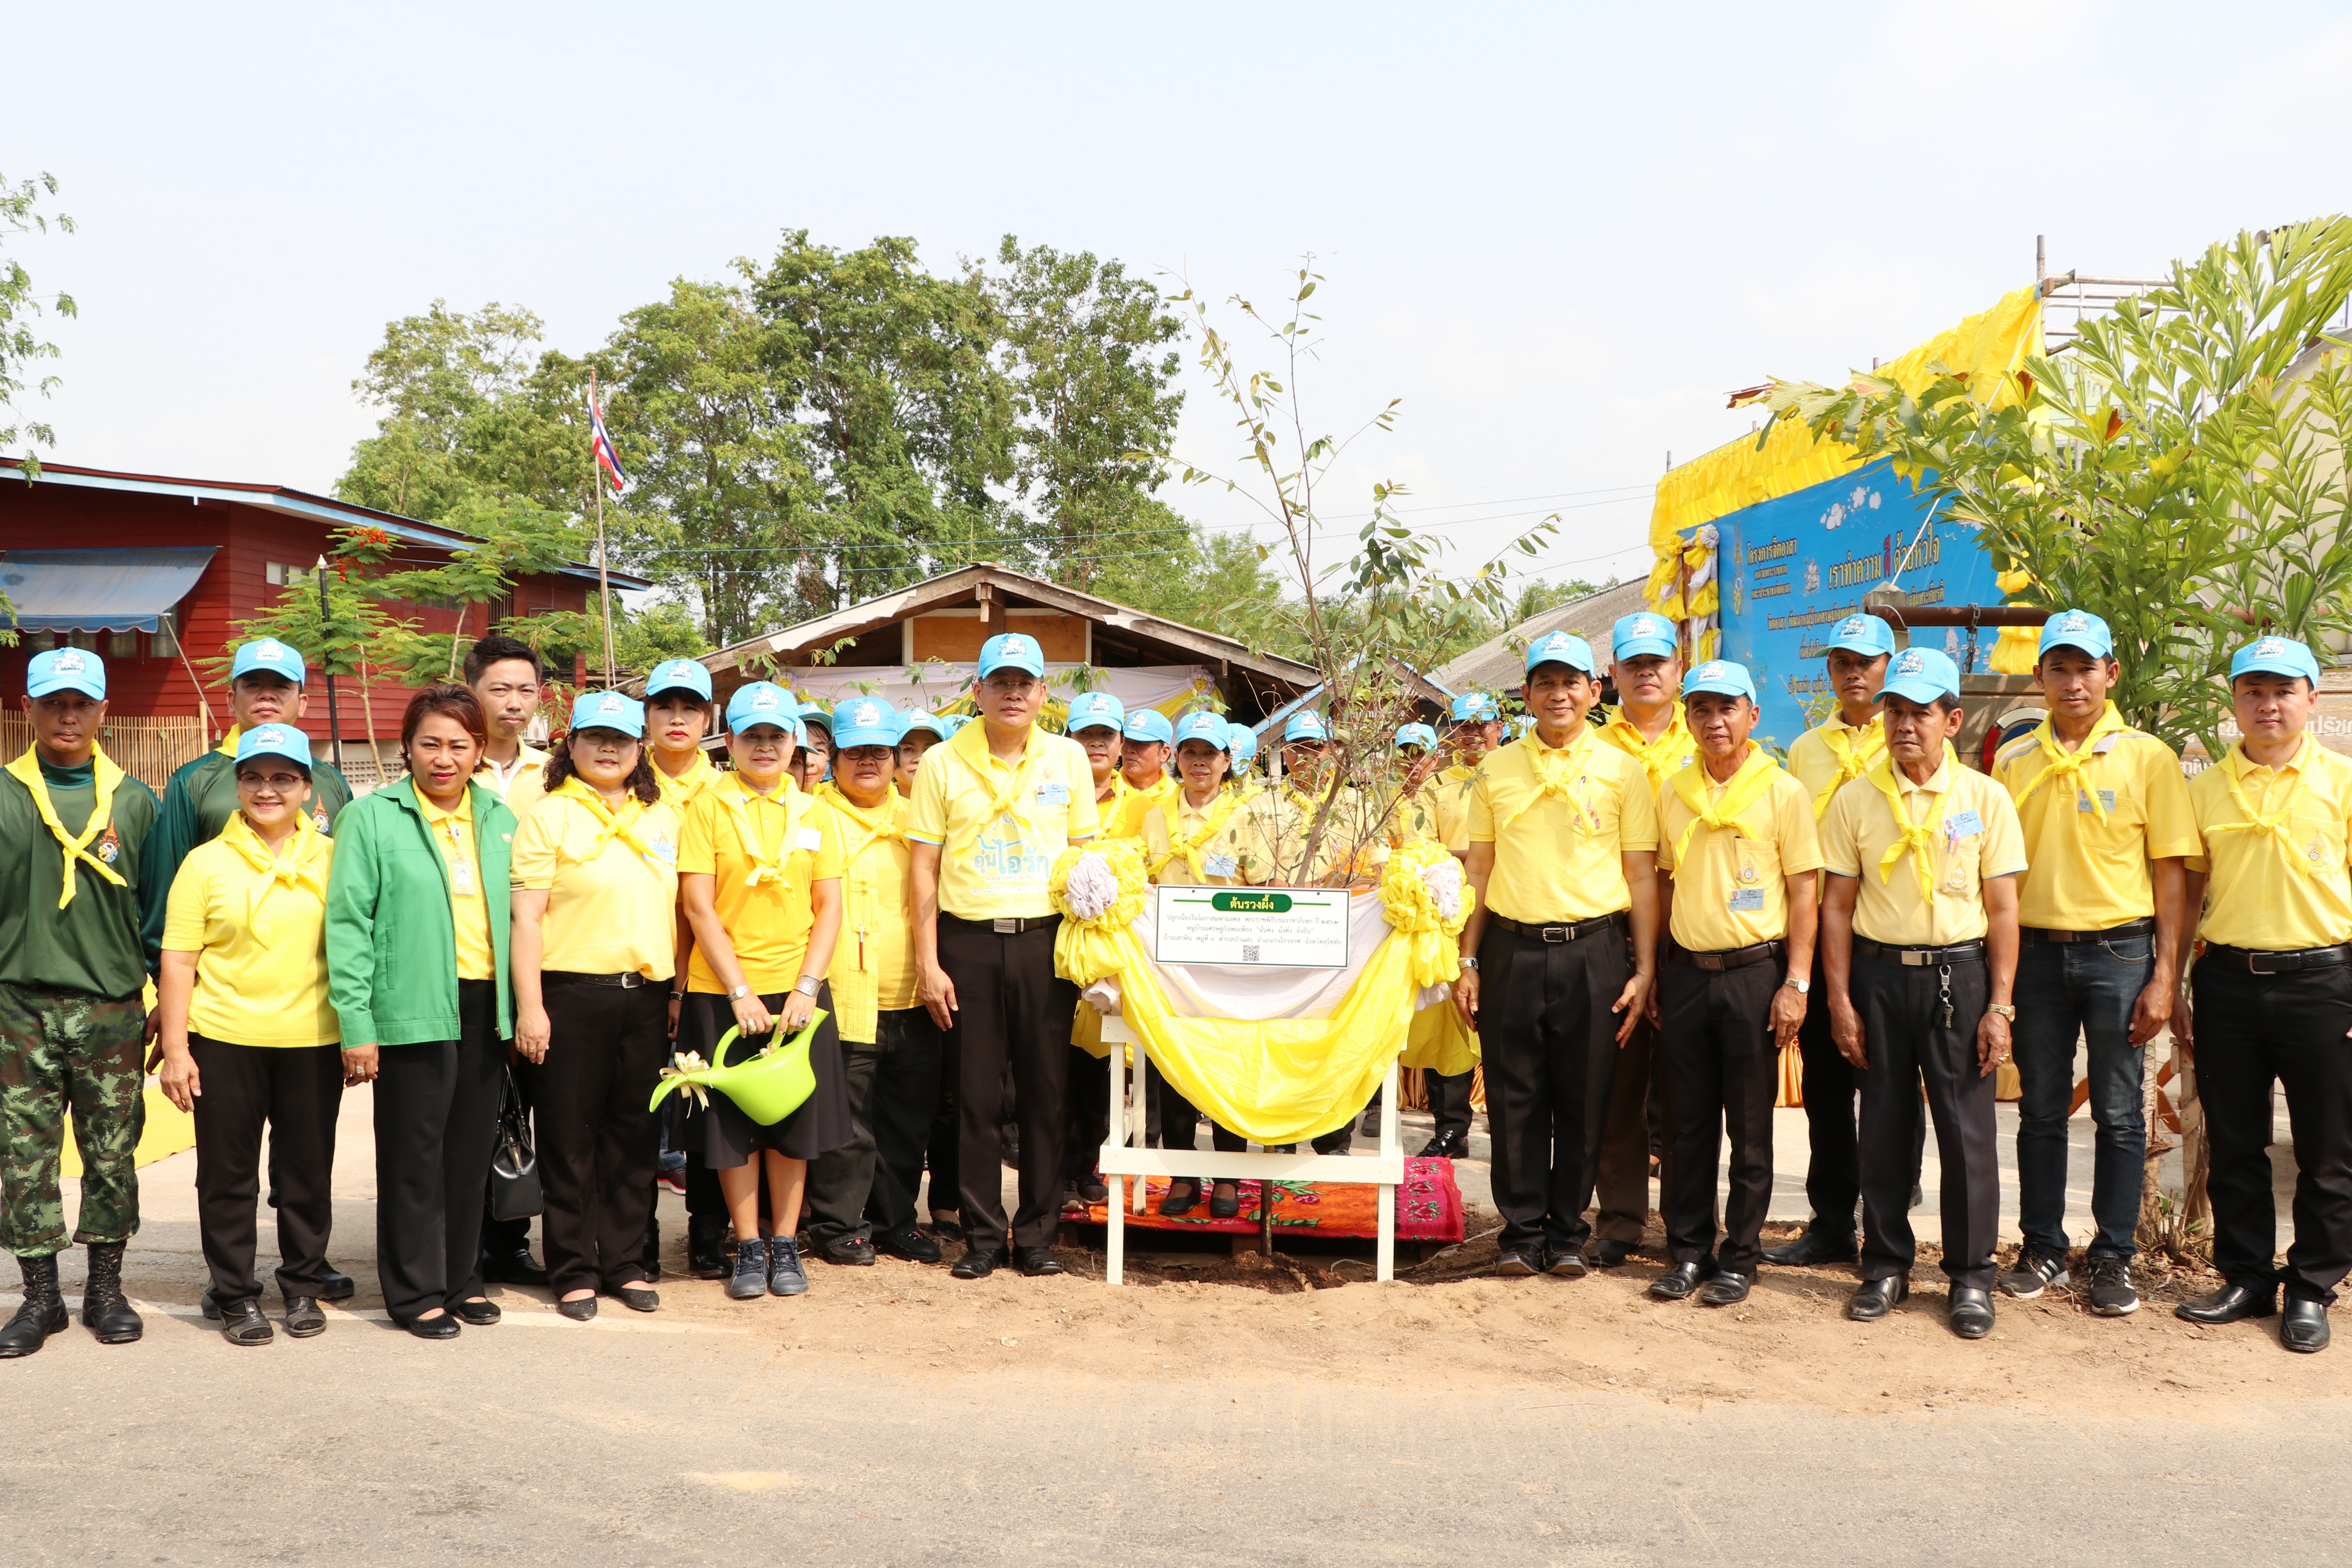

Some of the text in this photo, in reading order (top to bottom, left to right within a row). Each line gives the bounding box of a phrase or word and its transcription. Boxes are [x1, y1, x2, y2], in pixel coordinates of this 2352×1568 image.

[1747, 535, 1797, 566] โครงการจิตอาสา
[1829, 550, 1882, 590] เราทำความ
[1768, 613, 1786, 631] จิตอาสา
[973, 838, 1049, 879] อุ่นไอรัก
[1230, 894, 1274, 909] ต้นรวงผึ้ง
[1167, 912, 1241, 922] ปลูกเนื่องในโอกาสมหามงคล
[1187, 924, 1252, 933] หมู่บ้านเศรษฐกิจพอเพียง
[1196, 933, 1209, 943] หมู่ที่
[1257, 936, 1301, 944] อำเภอกงไกรลาศ
[1305, 937, 1342, 946] จังหวัดสุโขทัย
